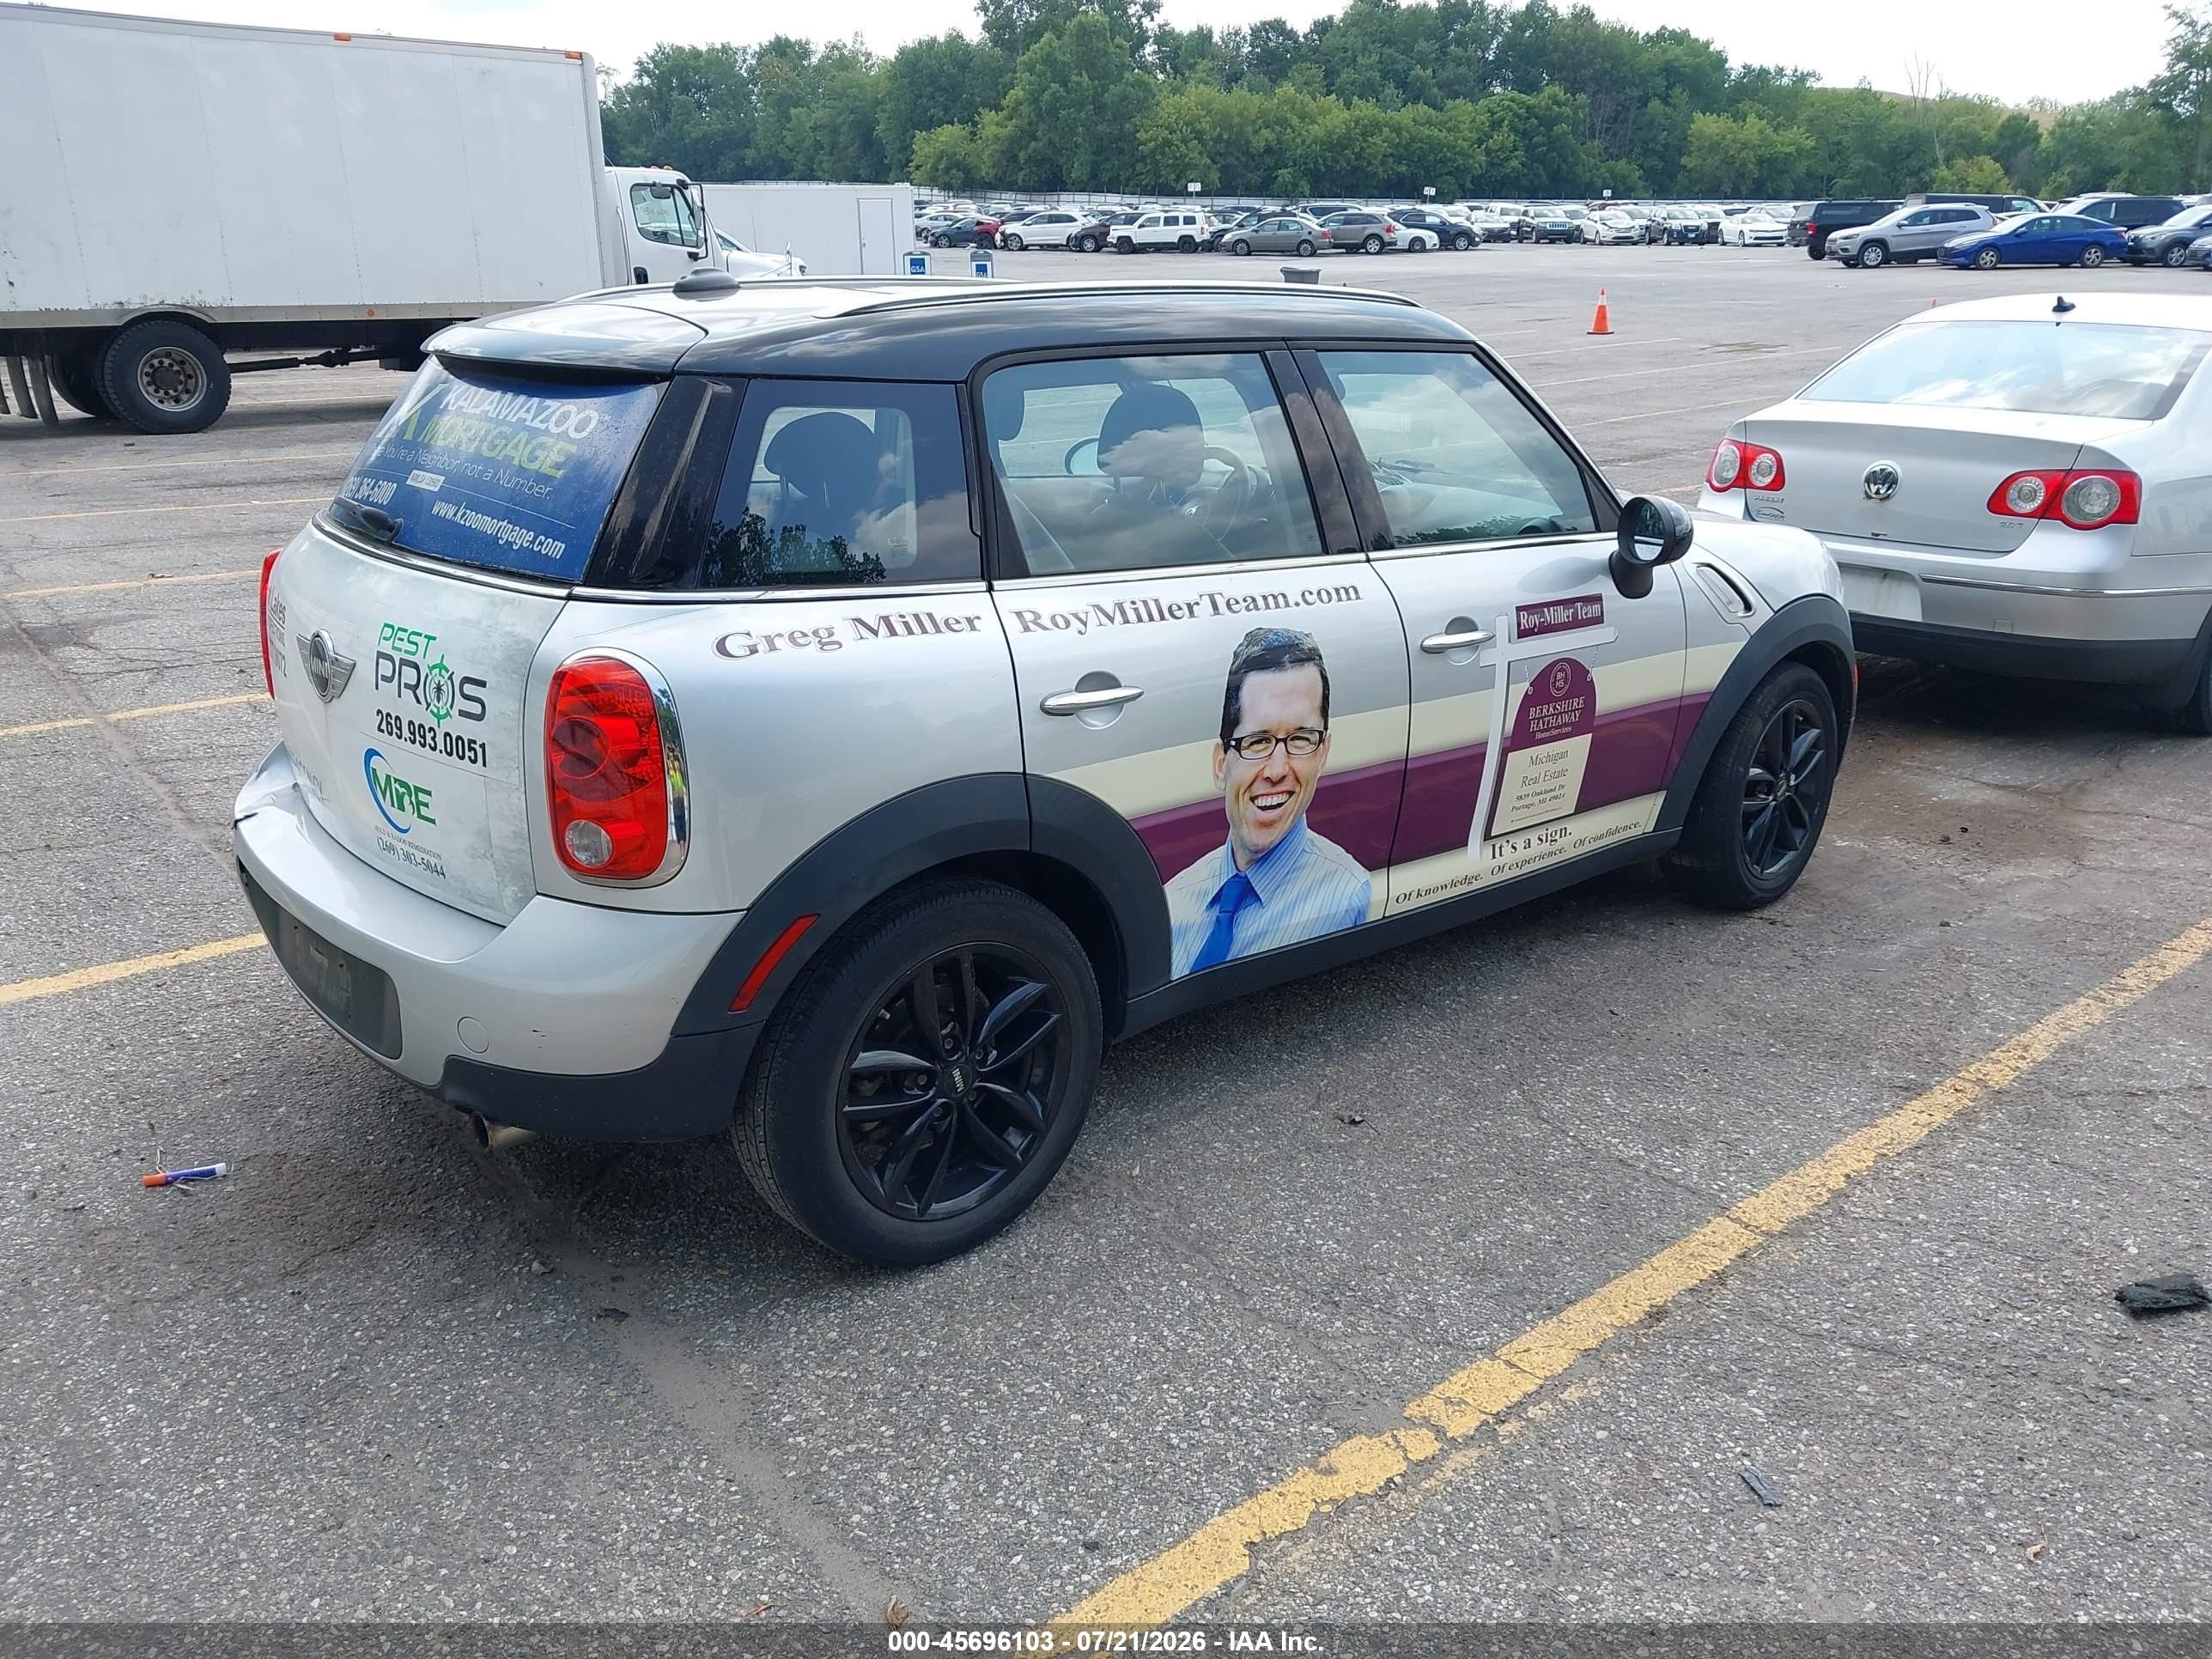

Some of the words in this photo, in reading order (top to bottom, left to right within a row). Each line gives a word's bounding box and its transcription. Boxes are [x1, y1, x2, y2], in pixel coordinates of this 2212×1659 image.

[440, 386, 599, 440] KALAMAZOO
[417, 414, 578, 478] MORTGAGE
[414, 447, 459, 473] Neighbor,
[461, 463, 483, 478] not
[483, 469, 492, 481] a
[495, 468, 555, 501] Number.
[431, 498, 566, 560] www.kzoomortgage.com
[713, 623, 843, 660] Greg
[846, 611, 984, 641] Miller
[1012, 581, 1364, 637] RoyMillerTeam.com
[1519, 605, 1574, 633] Roy-Miller
[1576, 599, 1602, 620] Team
[378, 623, 438, 660] PEST
[310, 662, 330, 680] MINI
[1555, 679, 1565, 688] HS
[1556, 672, 1565, 680] BH
[374, 652, 489, 723] PROS
[1528, 696, 1586, 720] BERKSHIRE
[1529, 709, 1582, 732] HATHAWAY
[376, 708, 488, 767] 269.993.0051
[1534, 726, 1572, 740] HomeServices
[1528, 748, 1569, 768] Michigan
[1520, 771, 1541, 788] Real
[1543, 769, 1568, 782] Estate
[1531, 786, 1557, 798] Oakland
[1511, 802, 1536, 812] Portage,
[376, 836, 400, 860] (269)
[400, 848, 446, 879] 303-5044
[408, 840, 442, 860] REMEDIATION
[1490, 839, 1517, 860] It's
[1522, 837, 1532, 850] a
[1537, 826, 1573, 846] sign.
[1395, 890, 1417, 904] Of
[1417, 872, 1483, 899] knowledge.
[1491, 863, 1508, 877] Of
[1508, 845, 1567, 872] experience.
[1573, 837, 1588, 849] Of
[1589, 819, 1643, 845] confidence.
[951, 1067, 965, 1092] MINI
